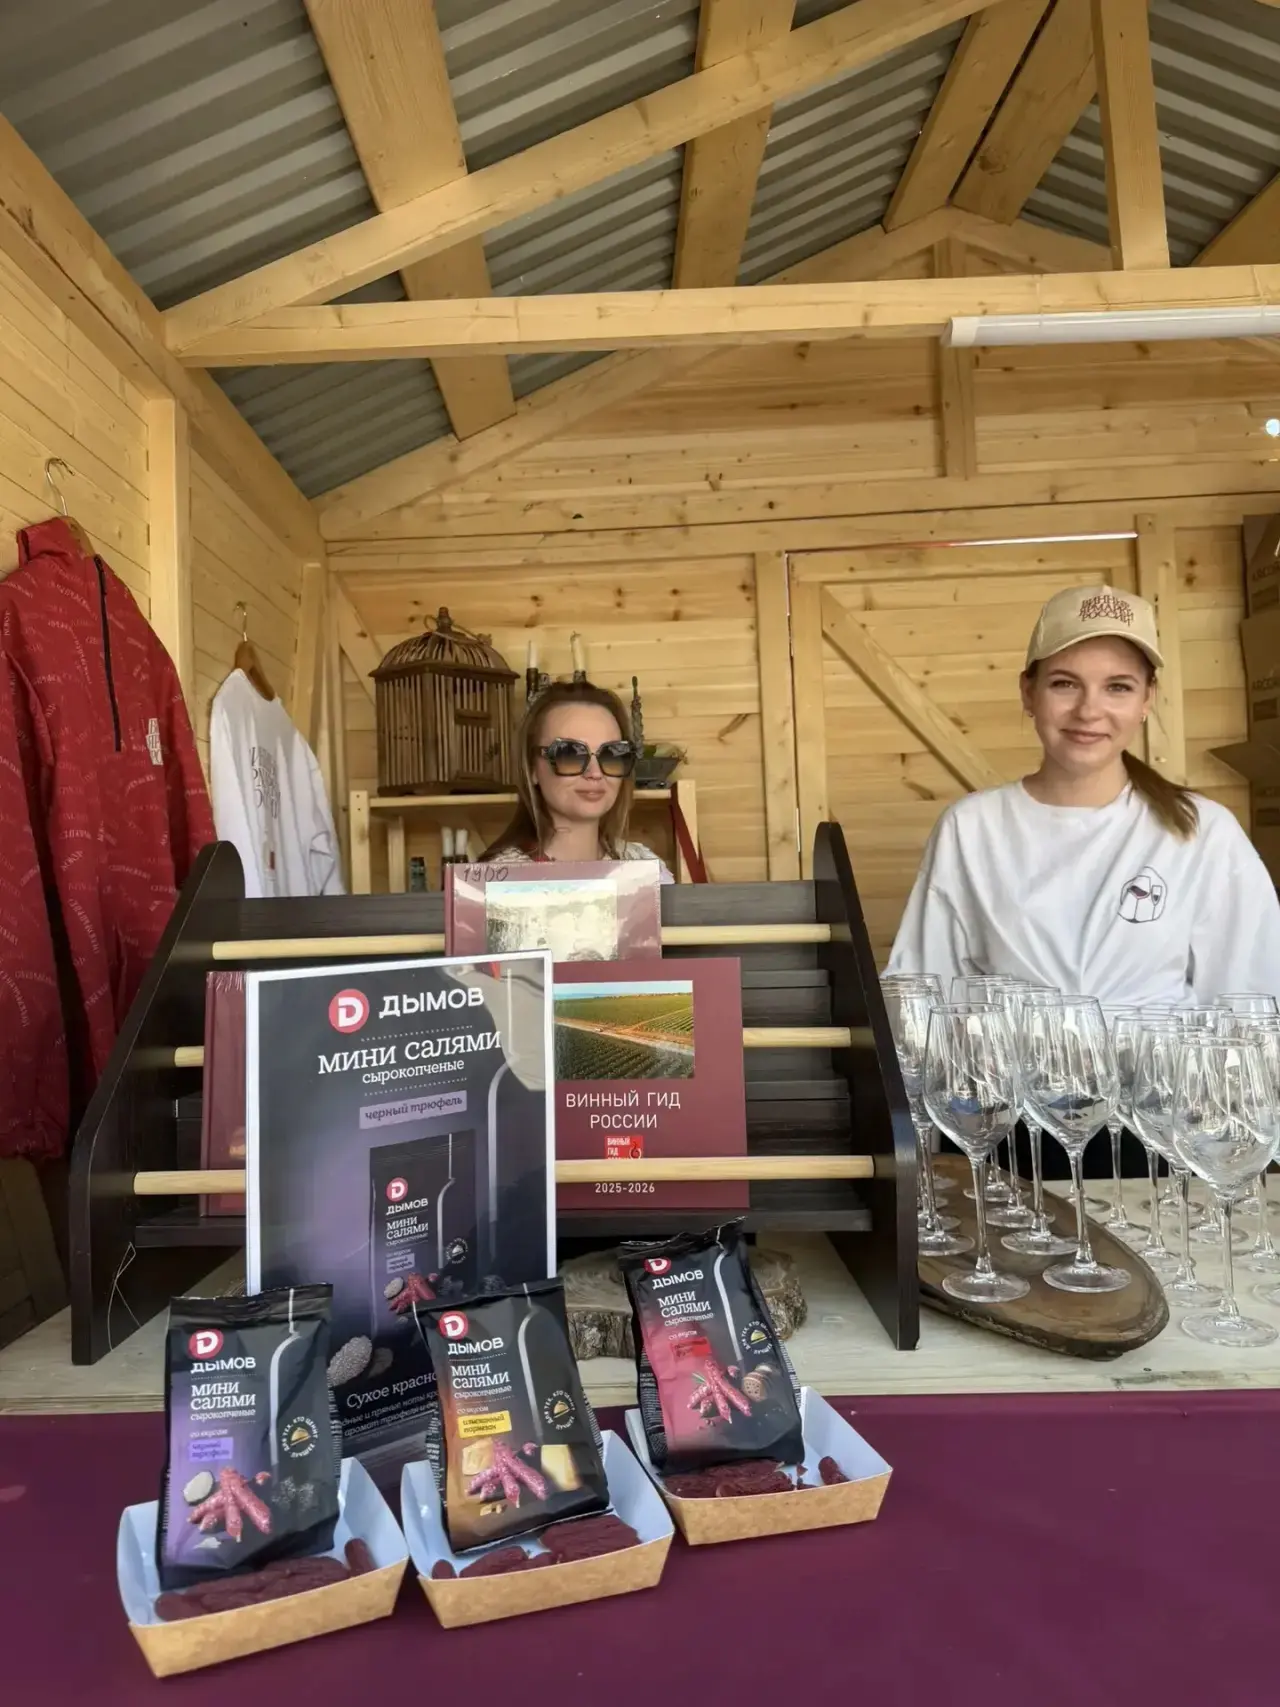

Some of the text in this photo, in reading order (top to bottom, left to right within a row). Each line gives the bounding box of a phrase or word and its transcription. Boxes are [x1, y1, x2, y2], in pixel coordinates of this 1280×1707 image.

[463, 866, 509, 882] 1900
[379, 987, 484, 1019] ДЫМОВ
[405, 1031, 502, 1061] салями
[362, 1059, 465, 1085] сырокопченые
[365, 1095, 463, 1121] черный трюфель
[566, 1089, 681, 1109] ВИННЫЙ ГИД
[590, 1114, 657, 1129] РОССИИ
[595, 1183, 655, 1193] 2025-2026
[386, 1198, 429, 1215] ДЫМОВ
[652, 1269, 704, 1290] ДЫМОВ
[448, 1337, 504, 1355] ДЫМОВ
[190, 1357, 257, 1374] ДЫМОВ
[346, 1387, 390, 1409] Сухое
